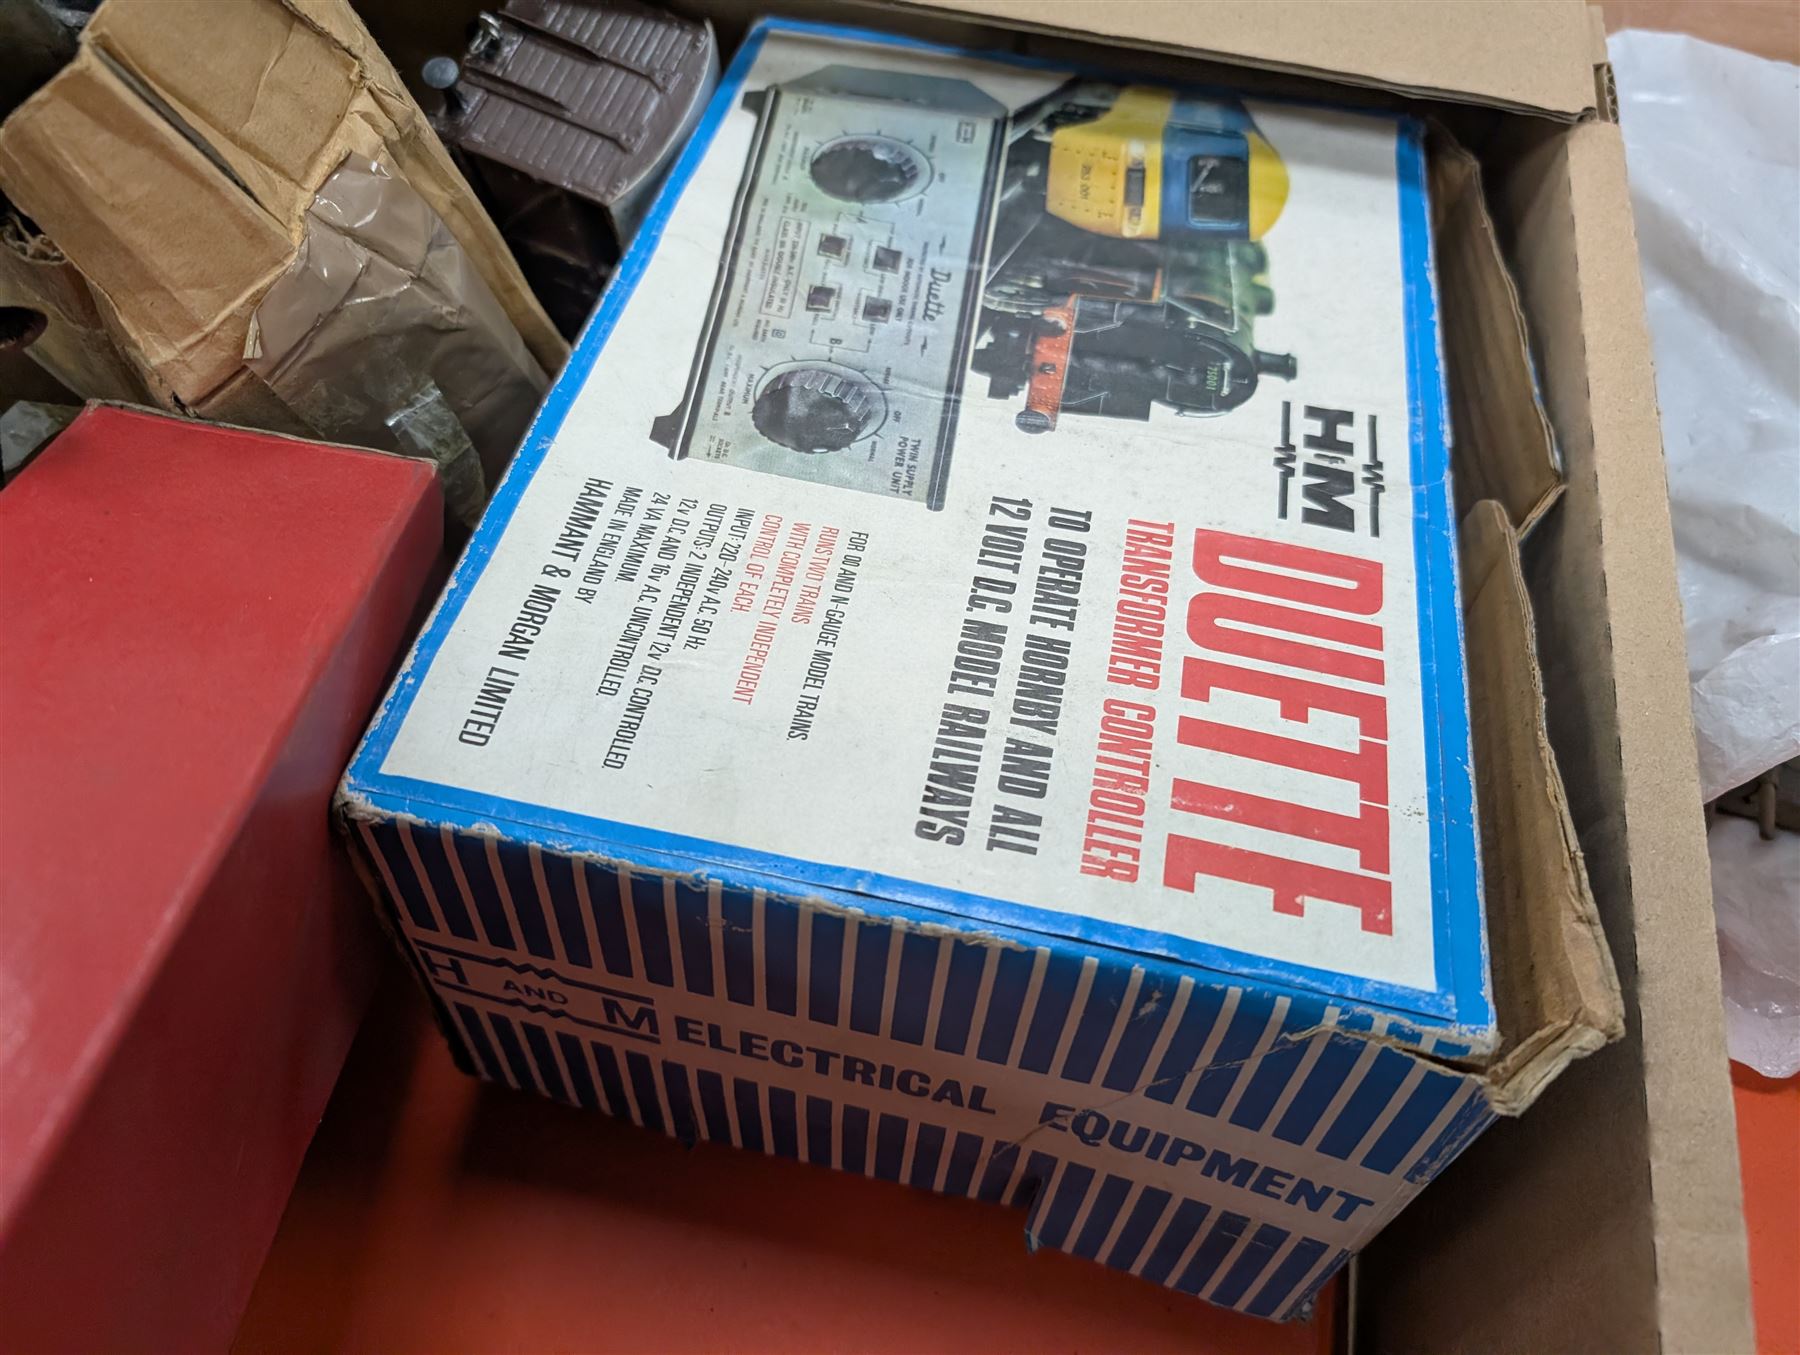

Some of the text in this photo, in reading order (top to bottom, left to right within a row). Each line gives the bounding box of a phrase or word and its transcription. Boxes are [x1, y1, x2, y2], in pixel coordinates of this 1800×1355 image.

[920, 267, 950, 324] Duette
[828, 337, 842, 345] B
[741, 373, 755, 404] MAXIMUM
[891, 410, 901, 423] OFF
[893, 435, 908, 468] POWER
[901, 438, 921, 496] TWIN SUPPLY
[1302, 405, 1355, 533] H&M
[677, 498, 699, 516] 12v
[728, 508, 756, 541] INPUT:
[574, 486, 643, 604] MADE IN ENGLAND BY
[614, 492, 671, 582] 24 VA MAXIMUM.
[657, 535, 682, 561] AND
[730, 514, 783, 612] CONTROL OF EACH.
[847, 531, 869, 552] FOR
[637, 584, 661, 603] A.C.
[647, 563, 671, 582] 16v
[791, 526, 840, 624] RUNS TWO TRAINS
[834, 567, 857, 593] AND
[458, 477, 614, 747] HAMMANT & MORGAN LIMITED
[691, 618, 713, 634] 50
[697, 595, 721, 615] A.C.
[732, 523, 812, 705] WITH COMPLETELY INDEPENDENT
[816, 595, 850, 648] N-GAUGE
[596, 606, 653, 696] UNCONTROLLED.
[601, 503, 728, 769] OUTPUTS: 2 INDEPENDENT 12v D.C. CONTROLLED.
[683, 635, 707, 650] Hz.
[802, 649, 833, 690] MODEL
[914, 496, 1033, 846] 12 VOLT D.C. MODEL RAILWAYS
[986, 507, 1093, 856] TO OPERATE HORNBY AND ALL
[786, 694, 820, 741] TRAINS.
[1080, 519, 1175, 884] TRANSFORMER CONTROLLER
[1163, 528, 1393, 937] DUETTE
[420, 950, 1376, 1222] H AND M ELECTRICAL EQUIPMENT
